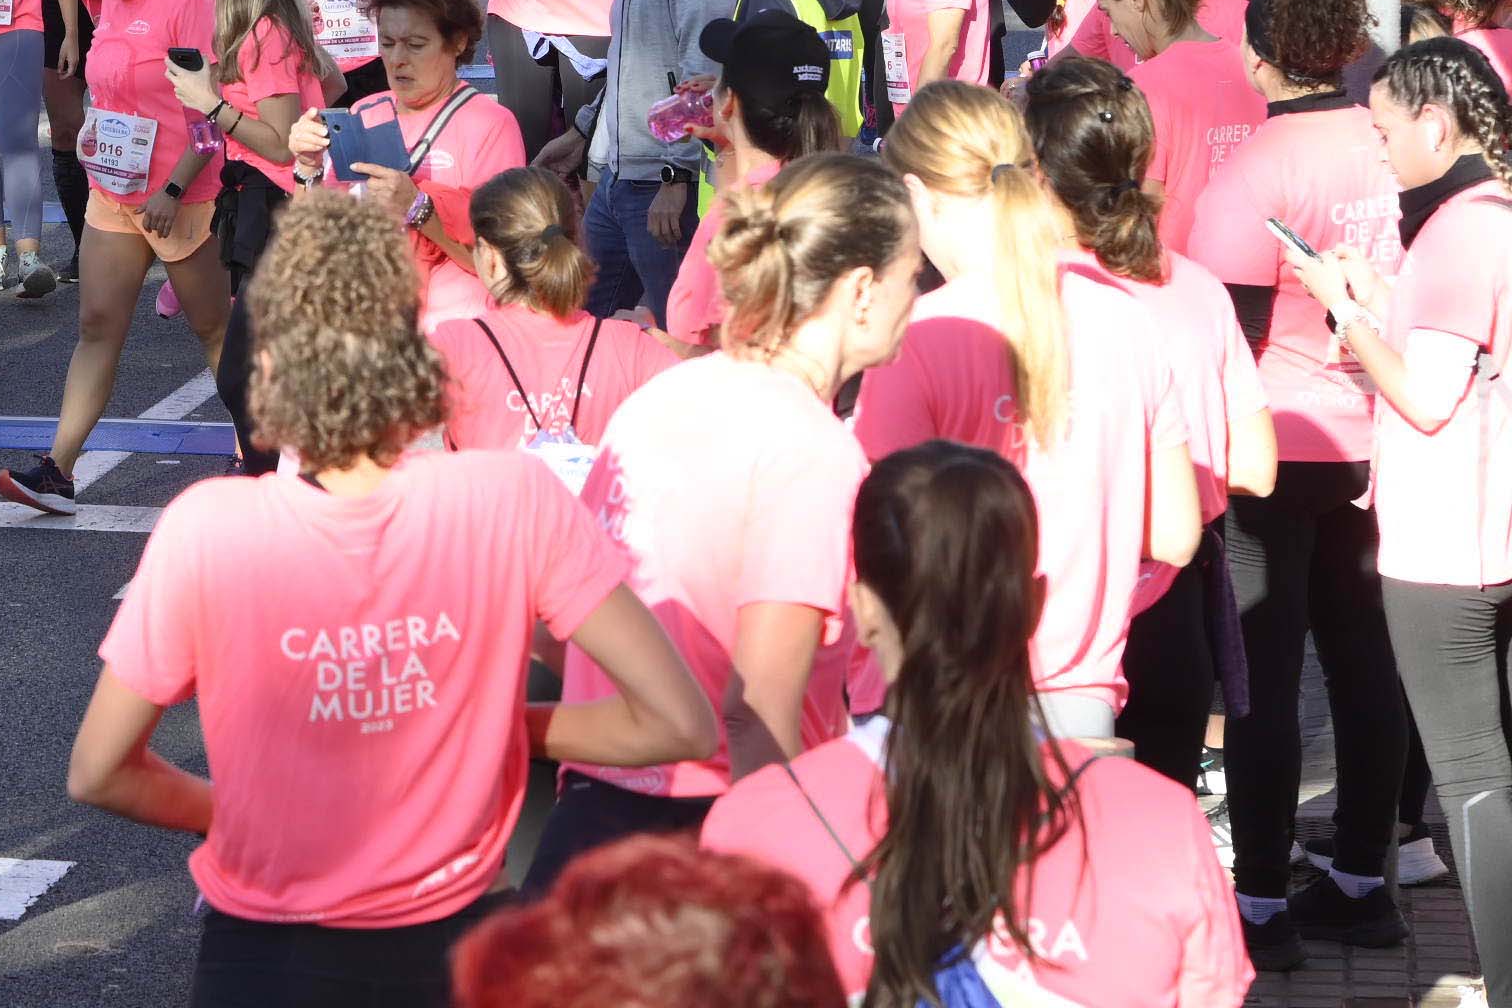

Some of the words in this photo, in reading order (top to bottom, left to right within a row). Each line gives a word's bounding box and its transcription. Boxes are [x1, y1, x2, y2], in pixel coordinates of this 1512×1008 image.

[326, 17, 351, 29] 016
[1206, 123, 1251, 146] CARRER
[99, 142, 123, 157] 016
[1210, 144, 1226, 162] DE
[101, 156, 119, 167] 14193
[1330, 194, 1403, 225] CARRER
[1344, 223, 1370, 242] DE
[279, 610, 461, 661] CARRERA
[317, 660, 367, 691] DE
[380, 650, 429, 686] LA
[308, 679, 437, 723] MUJER
